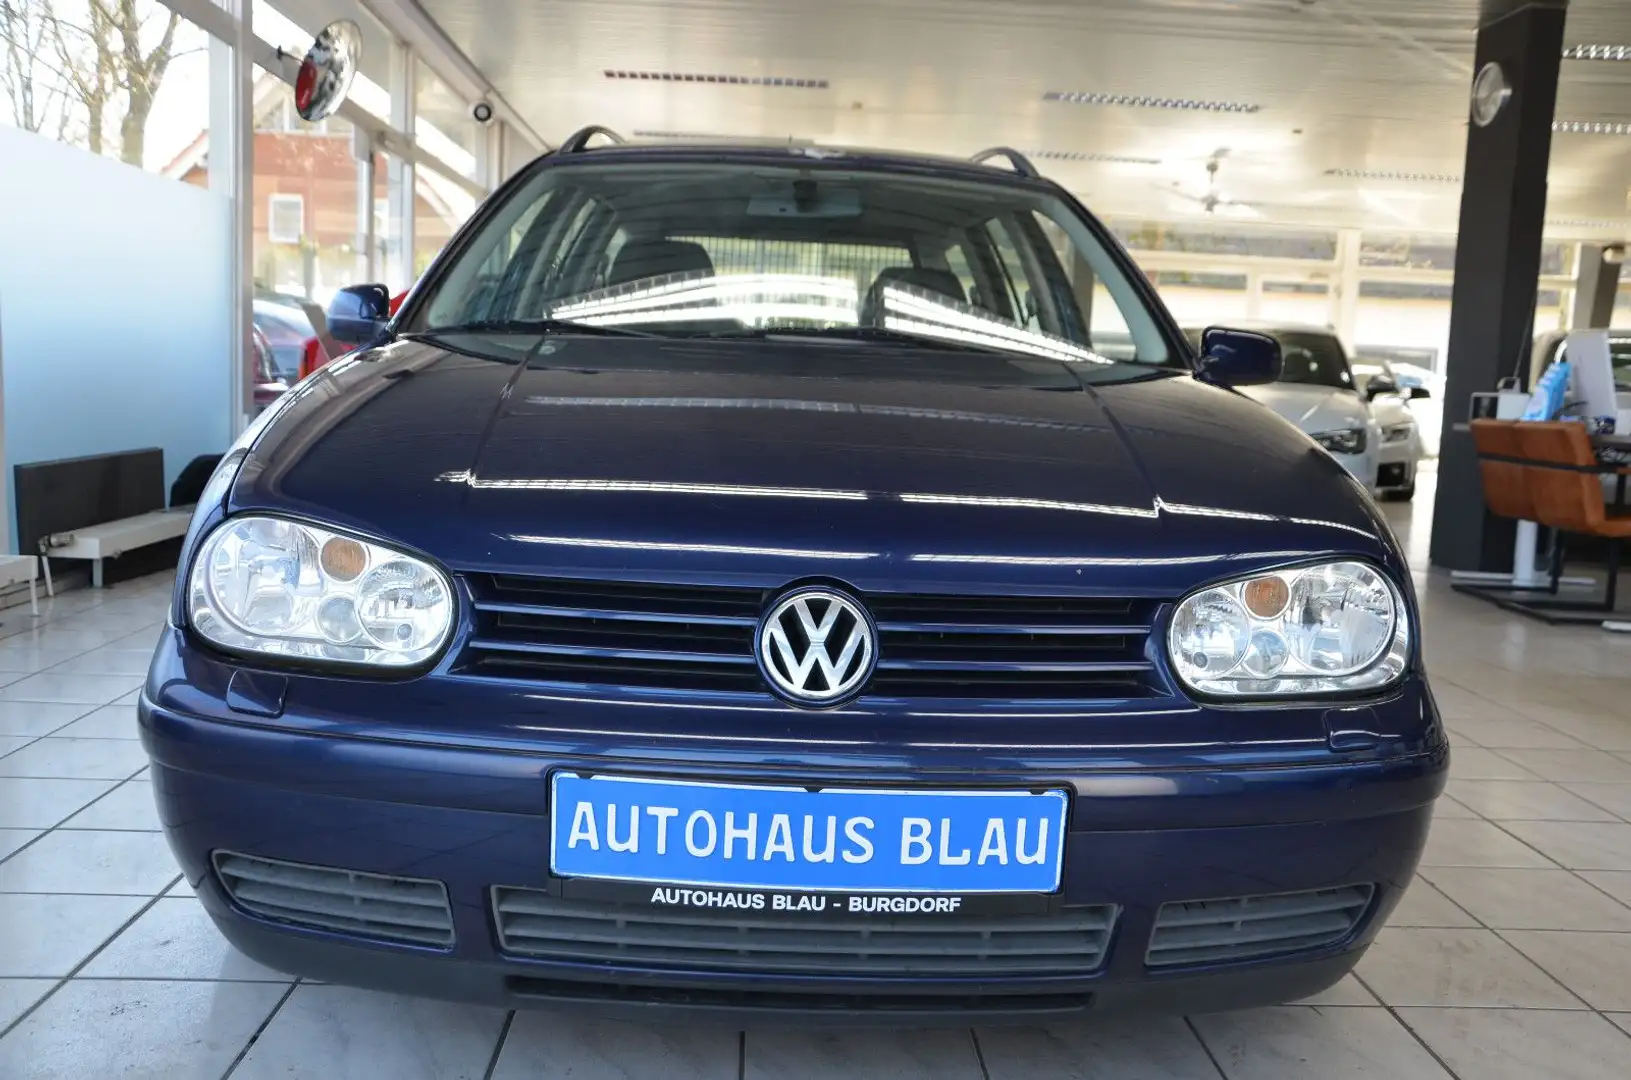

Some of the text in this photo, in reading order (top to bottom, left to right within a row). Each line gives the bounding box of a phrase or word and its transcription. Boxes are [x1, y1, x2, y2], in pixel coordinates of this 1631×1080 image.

[567, 801, 1049, 866] AUTOHAUS BLAU
[650, 887, 766, 910] AUTOHAUS
[772, 894, 826, 912] BLAU
[848, 896, 962, 913] BURGDORF
